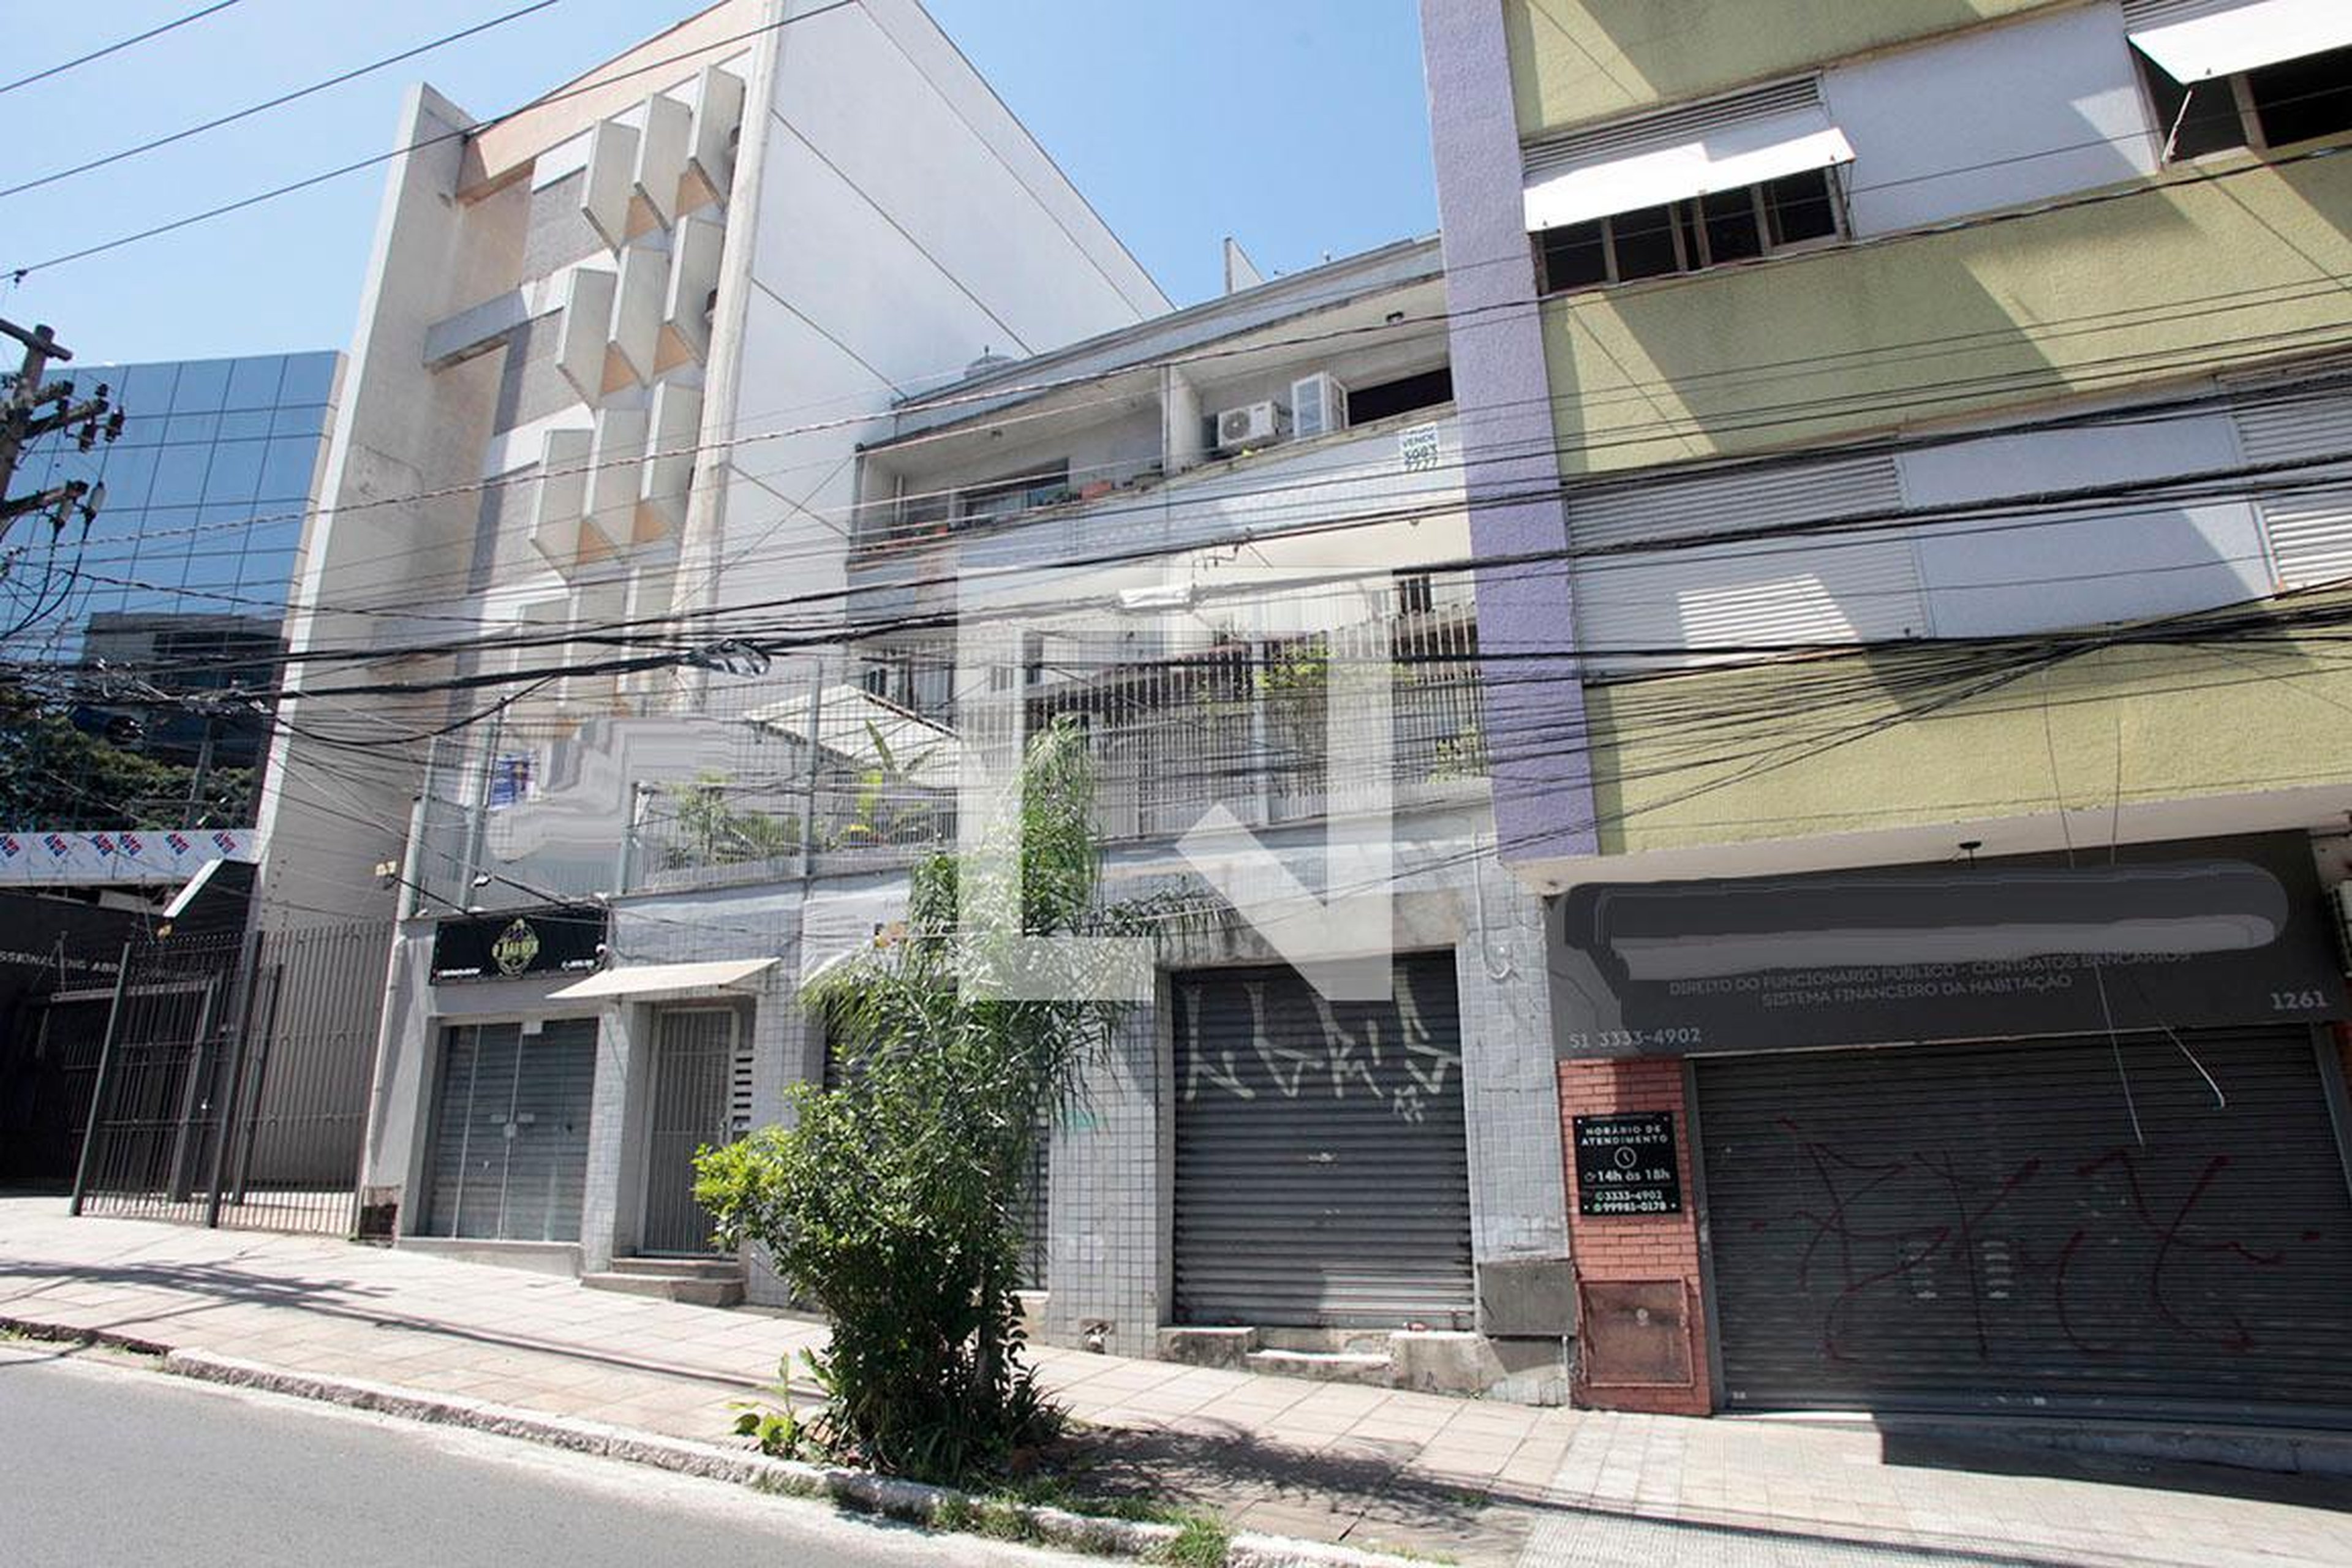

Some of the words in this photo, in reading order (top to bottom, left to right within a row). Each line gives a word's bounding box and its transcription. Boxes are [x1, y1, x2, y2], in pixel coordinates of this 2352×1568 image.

[1735, 976, 1760, 991] DO
[1762, 990, 1831, 1007] SISTEMA
[1834, 982, 1937, 1001] FINANCEIRO
[1942, 980, 1967, 995] DA
[2270, 991, 2328, 1010] 1261
[1569, 1033, 1589, 1049] 51
[1599, 1028, 1701, 1047] 3333-4902
[1645, 1124, 1660, 1134] DE
[1581, 1134, 1667, 1145] ATENDIMENTO
[1597, 1169, 1623, 1182] 14h
[1645, 1167, 1671, 1180] 18h
[1604, 1189, 1662, 1201] 3333-4902
